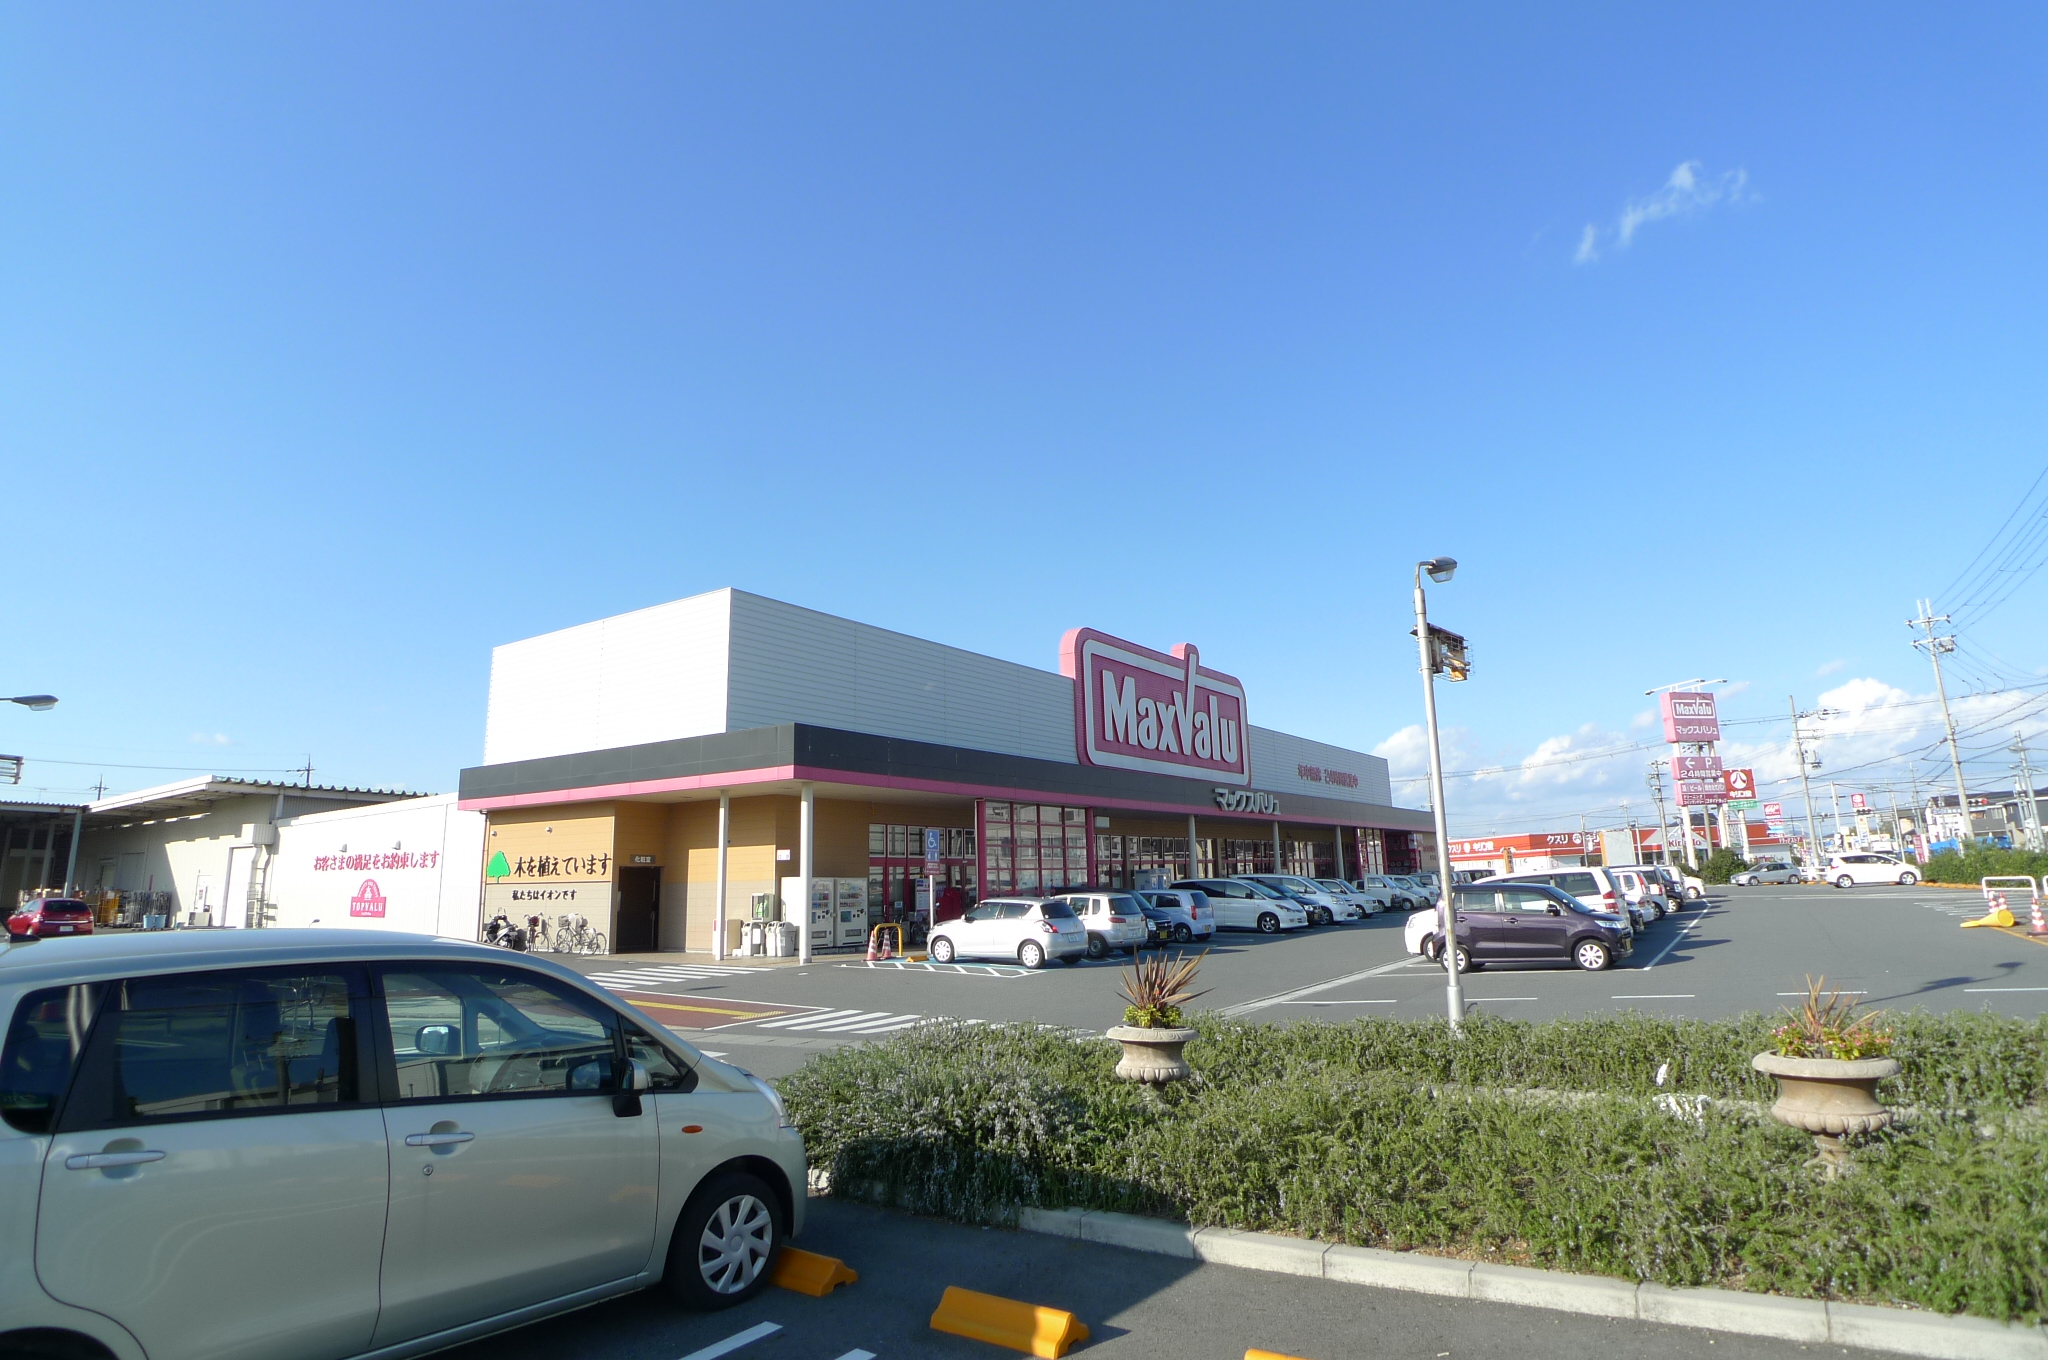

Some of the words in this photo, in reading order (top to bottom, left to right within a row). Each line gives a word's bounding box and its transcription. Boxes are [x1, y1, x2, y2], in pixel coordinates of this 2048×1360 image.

[1102, 653, 1238, 763] MaxValu
[1675, 697, 1712, 715] MaxValu
[1675, 725, 1718, 735] マックスバリュ
[1213, 787, 1282, 816] マックスバリュ
[1546, 833, 1569, 845] クスリ
[314, 851, 440, 871] お客さまの満足をお約束します
[514, 852, 612, 878] 木を植えています
[511, 889, 577, 901] 私たちはイオンです
[352, 901, 384, 912] TOPVALU
